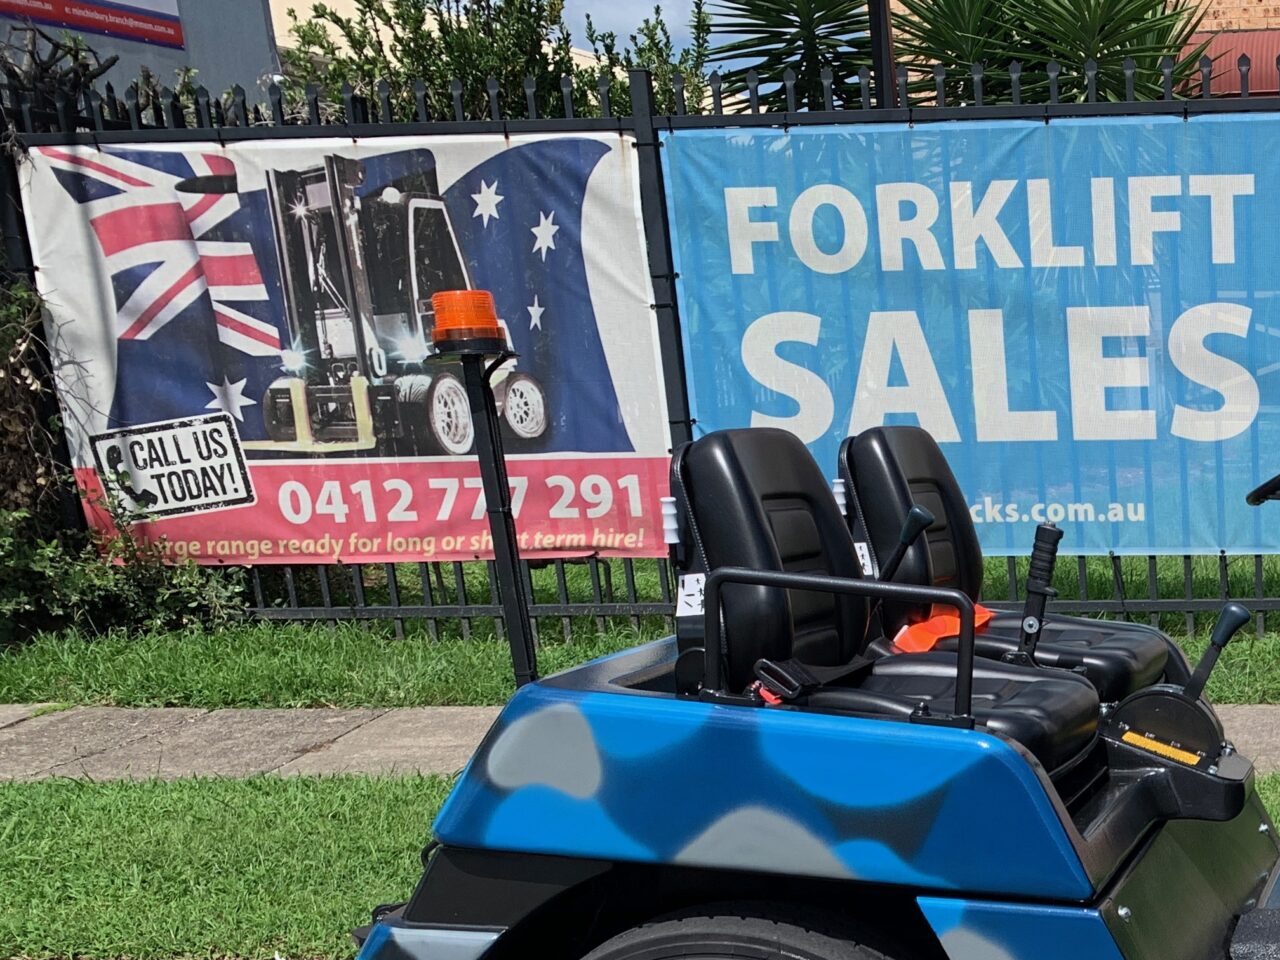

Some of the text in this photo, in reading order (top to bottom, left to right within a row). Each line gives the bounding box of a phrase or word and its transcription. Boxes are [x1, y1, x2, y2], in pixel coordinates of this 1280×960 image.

[724, 174, 1255, 275] FORKLIFT
[741, 302, 1260, 443] SALES
[129, 427, 228, 471] CALL US
[150, 462, 239, 505] TODAY!
[277, 474, 644, 524] 0412 777 291
[206, 538, 273, 560] range
[278, 533, 344, 560] ready
[348, 532, 382, 553] for
[386, 531, 436, 557] long
[441, 535, 465, 551] or
[470, 529, 529, 551] sht
[534, 531, 586, 550] term
[592, 528, 645, 549] hire!
